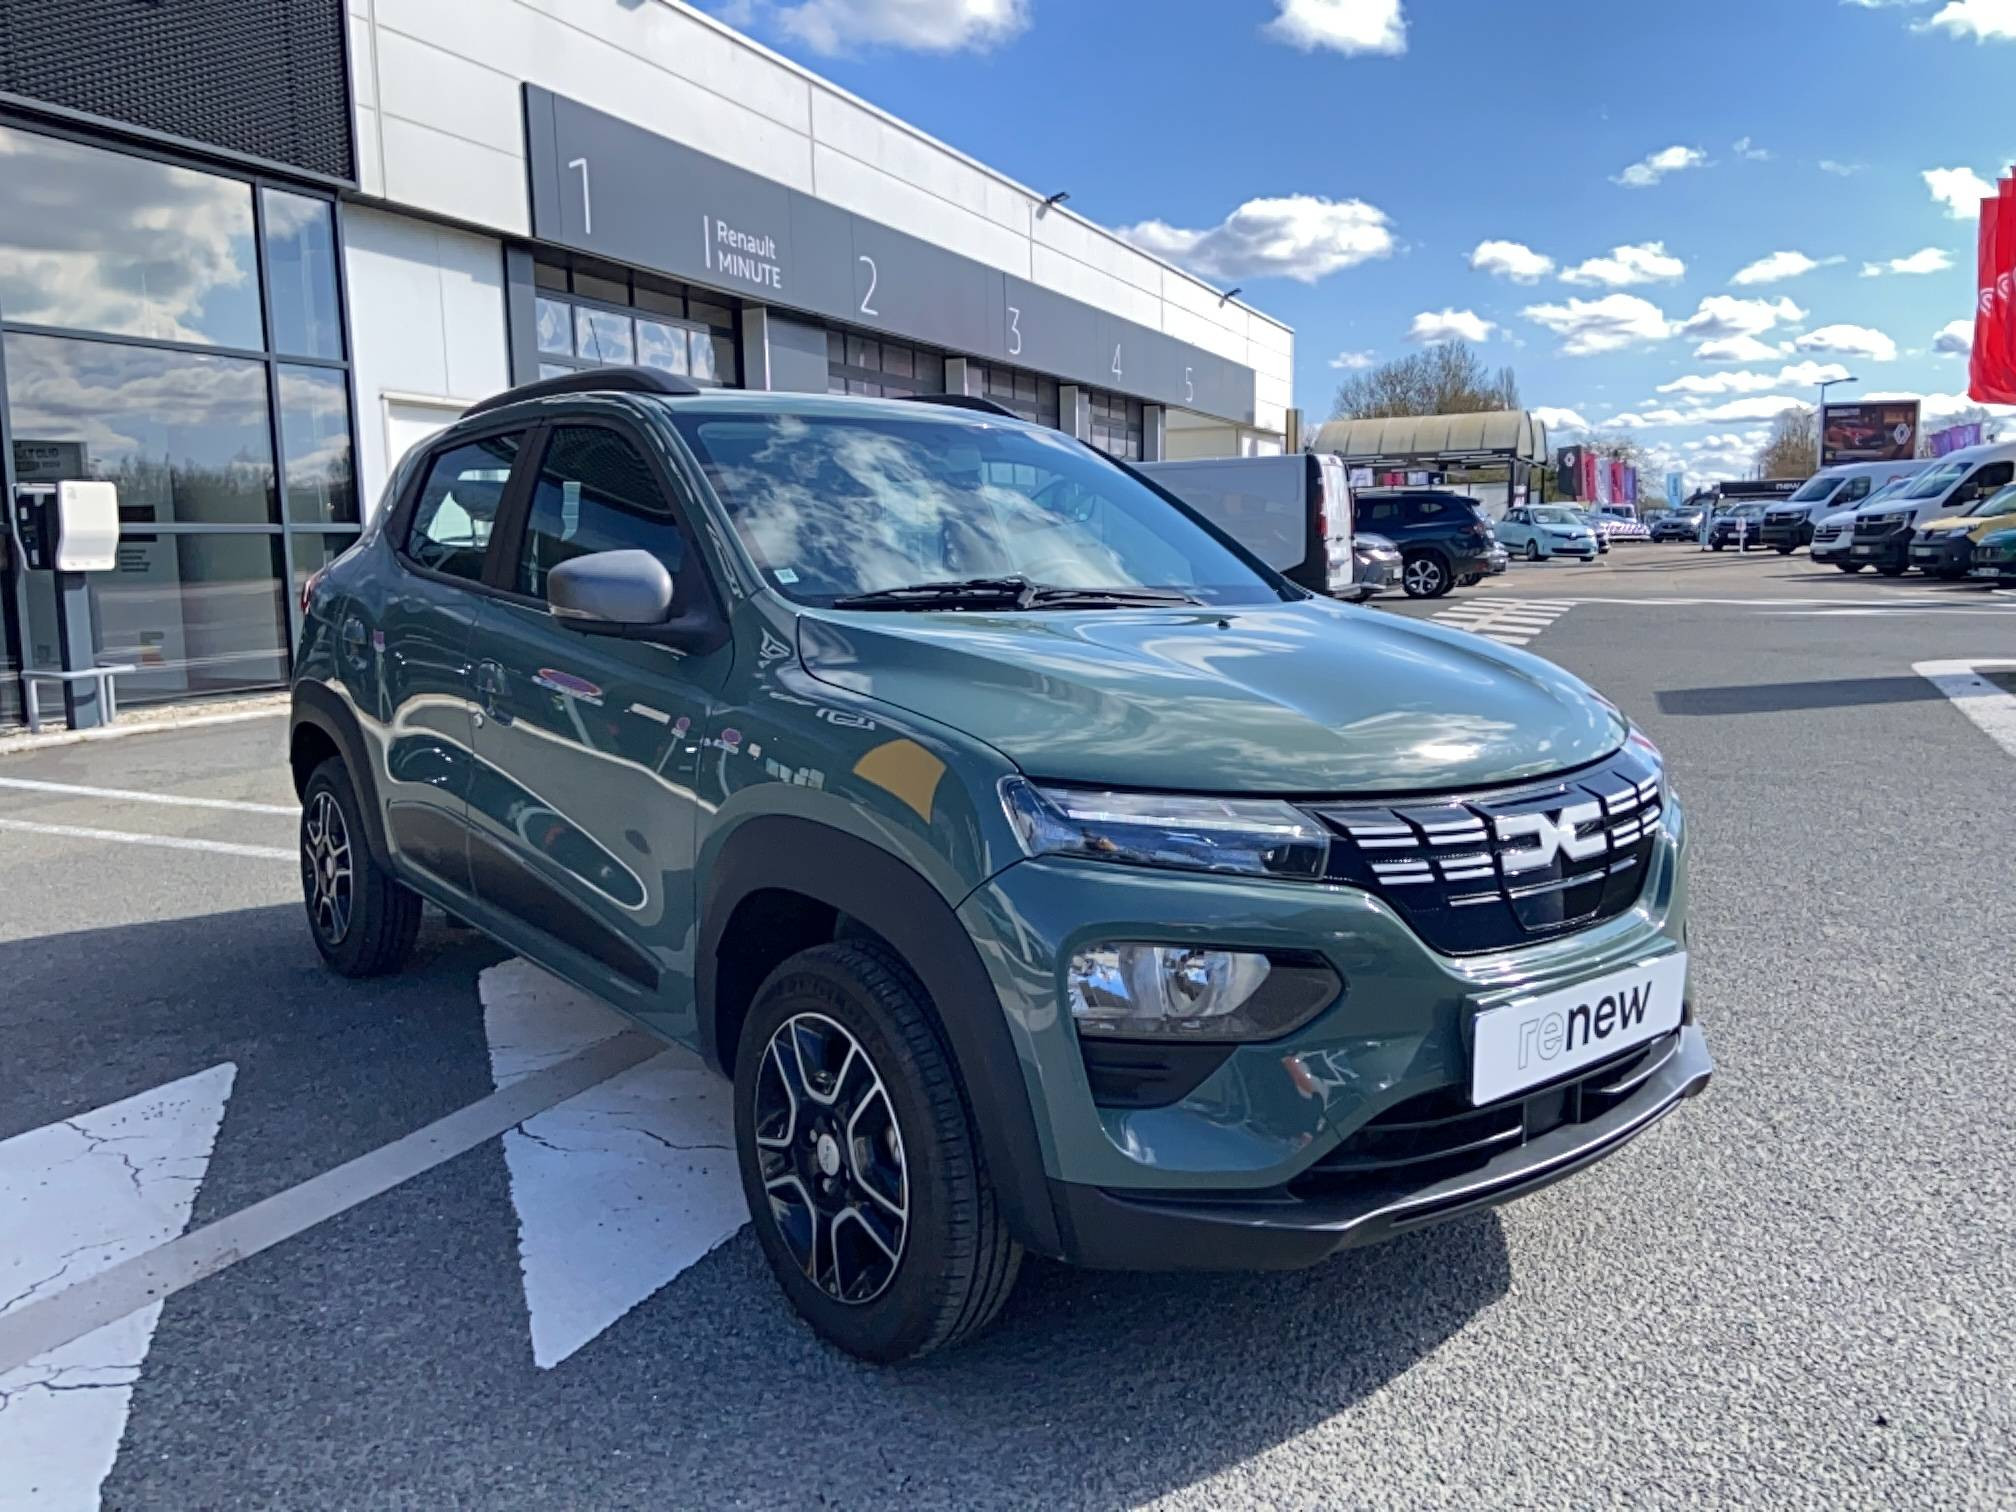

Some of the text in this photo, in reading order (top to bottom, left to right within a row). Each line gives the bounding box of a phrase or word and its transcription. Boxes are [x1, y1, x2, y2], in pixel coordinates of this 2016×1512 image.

[568, 156, 592, 235] 1
[716, 219, 776, 260] Renault
[717, 249, 782, 289] MINUTE
[859, 255, 879, 316] 2
[1007, 306, 1022, 355] 3
[1111, 343, 1123, 383] 4
[1184, 366, 1195, 403] 5
[1517, 980, 1653, 1071] renew
